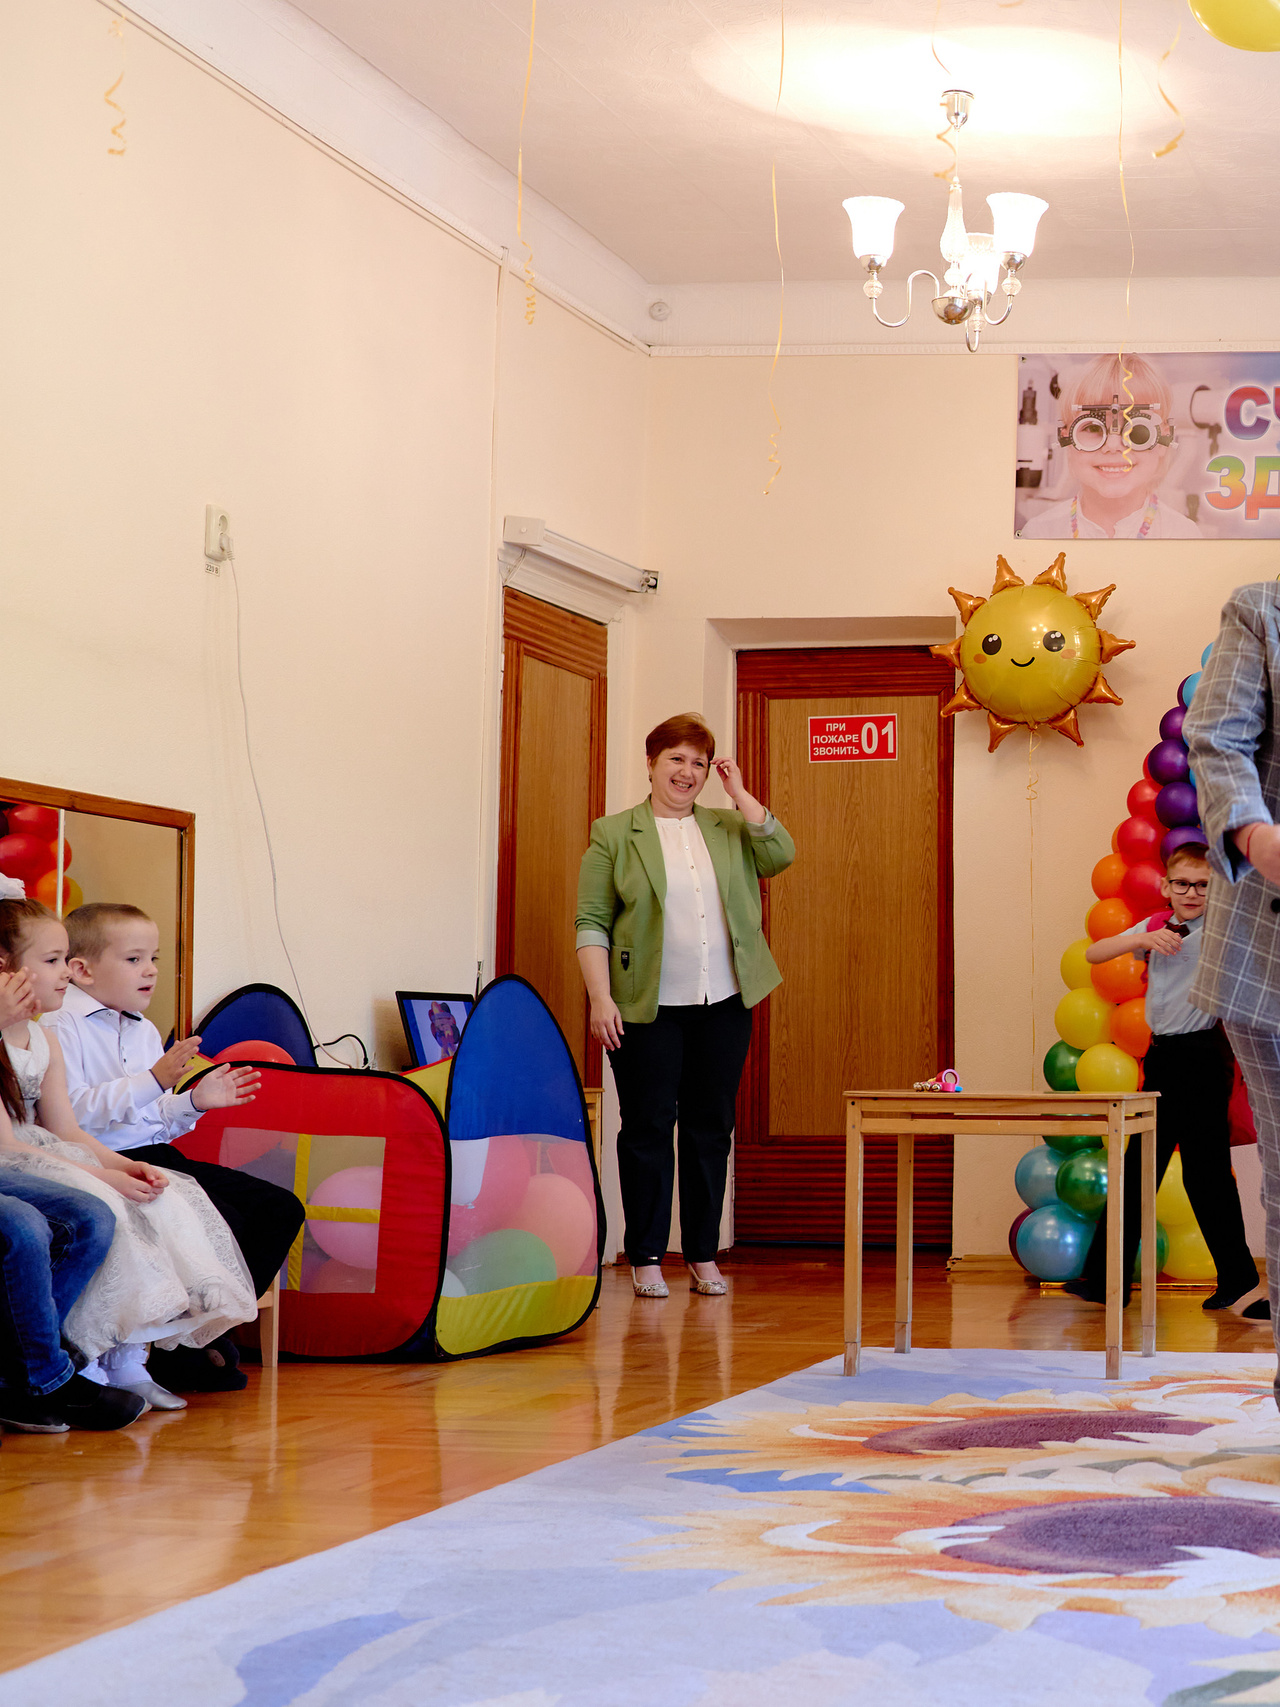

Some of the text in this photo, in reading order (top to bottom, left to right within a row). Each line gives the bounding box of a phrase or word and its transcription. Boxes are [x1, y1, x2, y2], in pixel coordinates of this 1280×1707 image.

[826, 722, 846, 732] ПРИ
[812, 734, 859, 744] ПОЖАРЕ
[861, 721, 894, 754] 01
[813, 746, 859, 756] ЗВОНИТЬ
